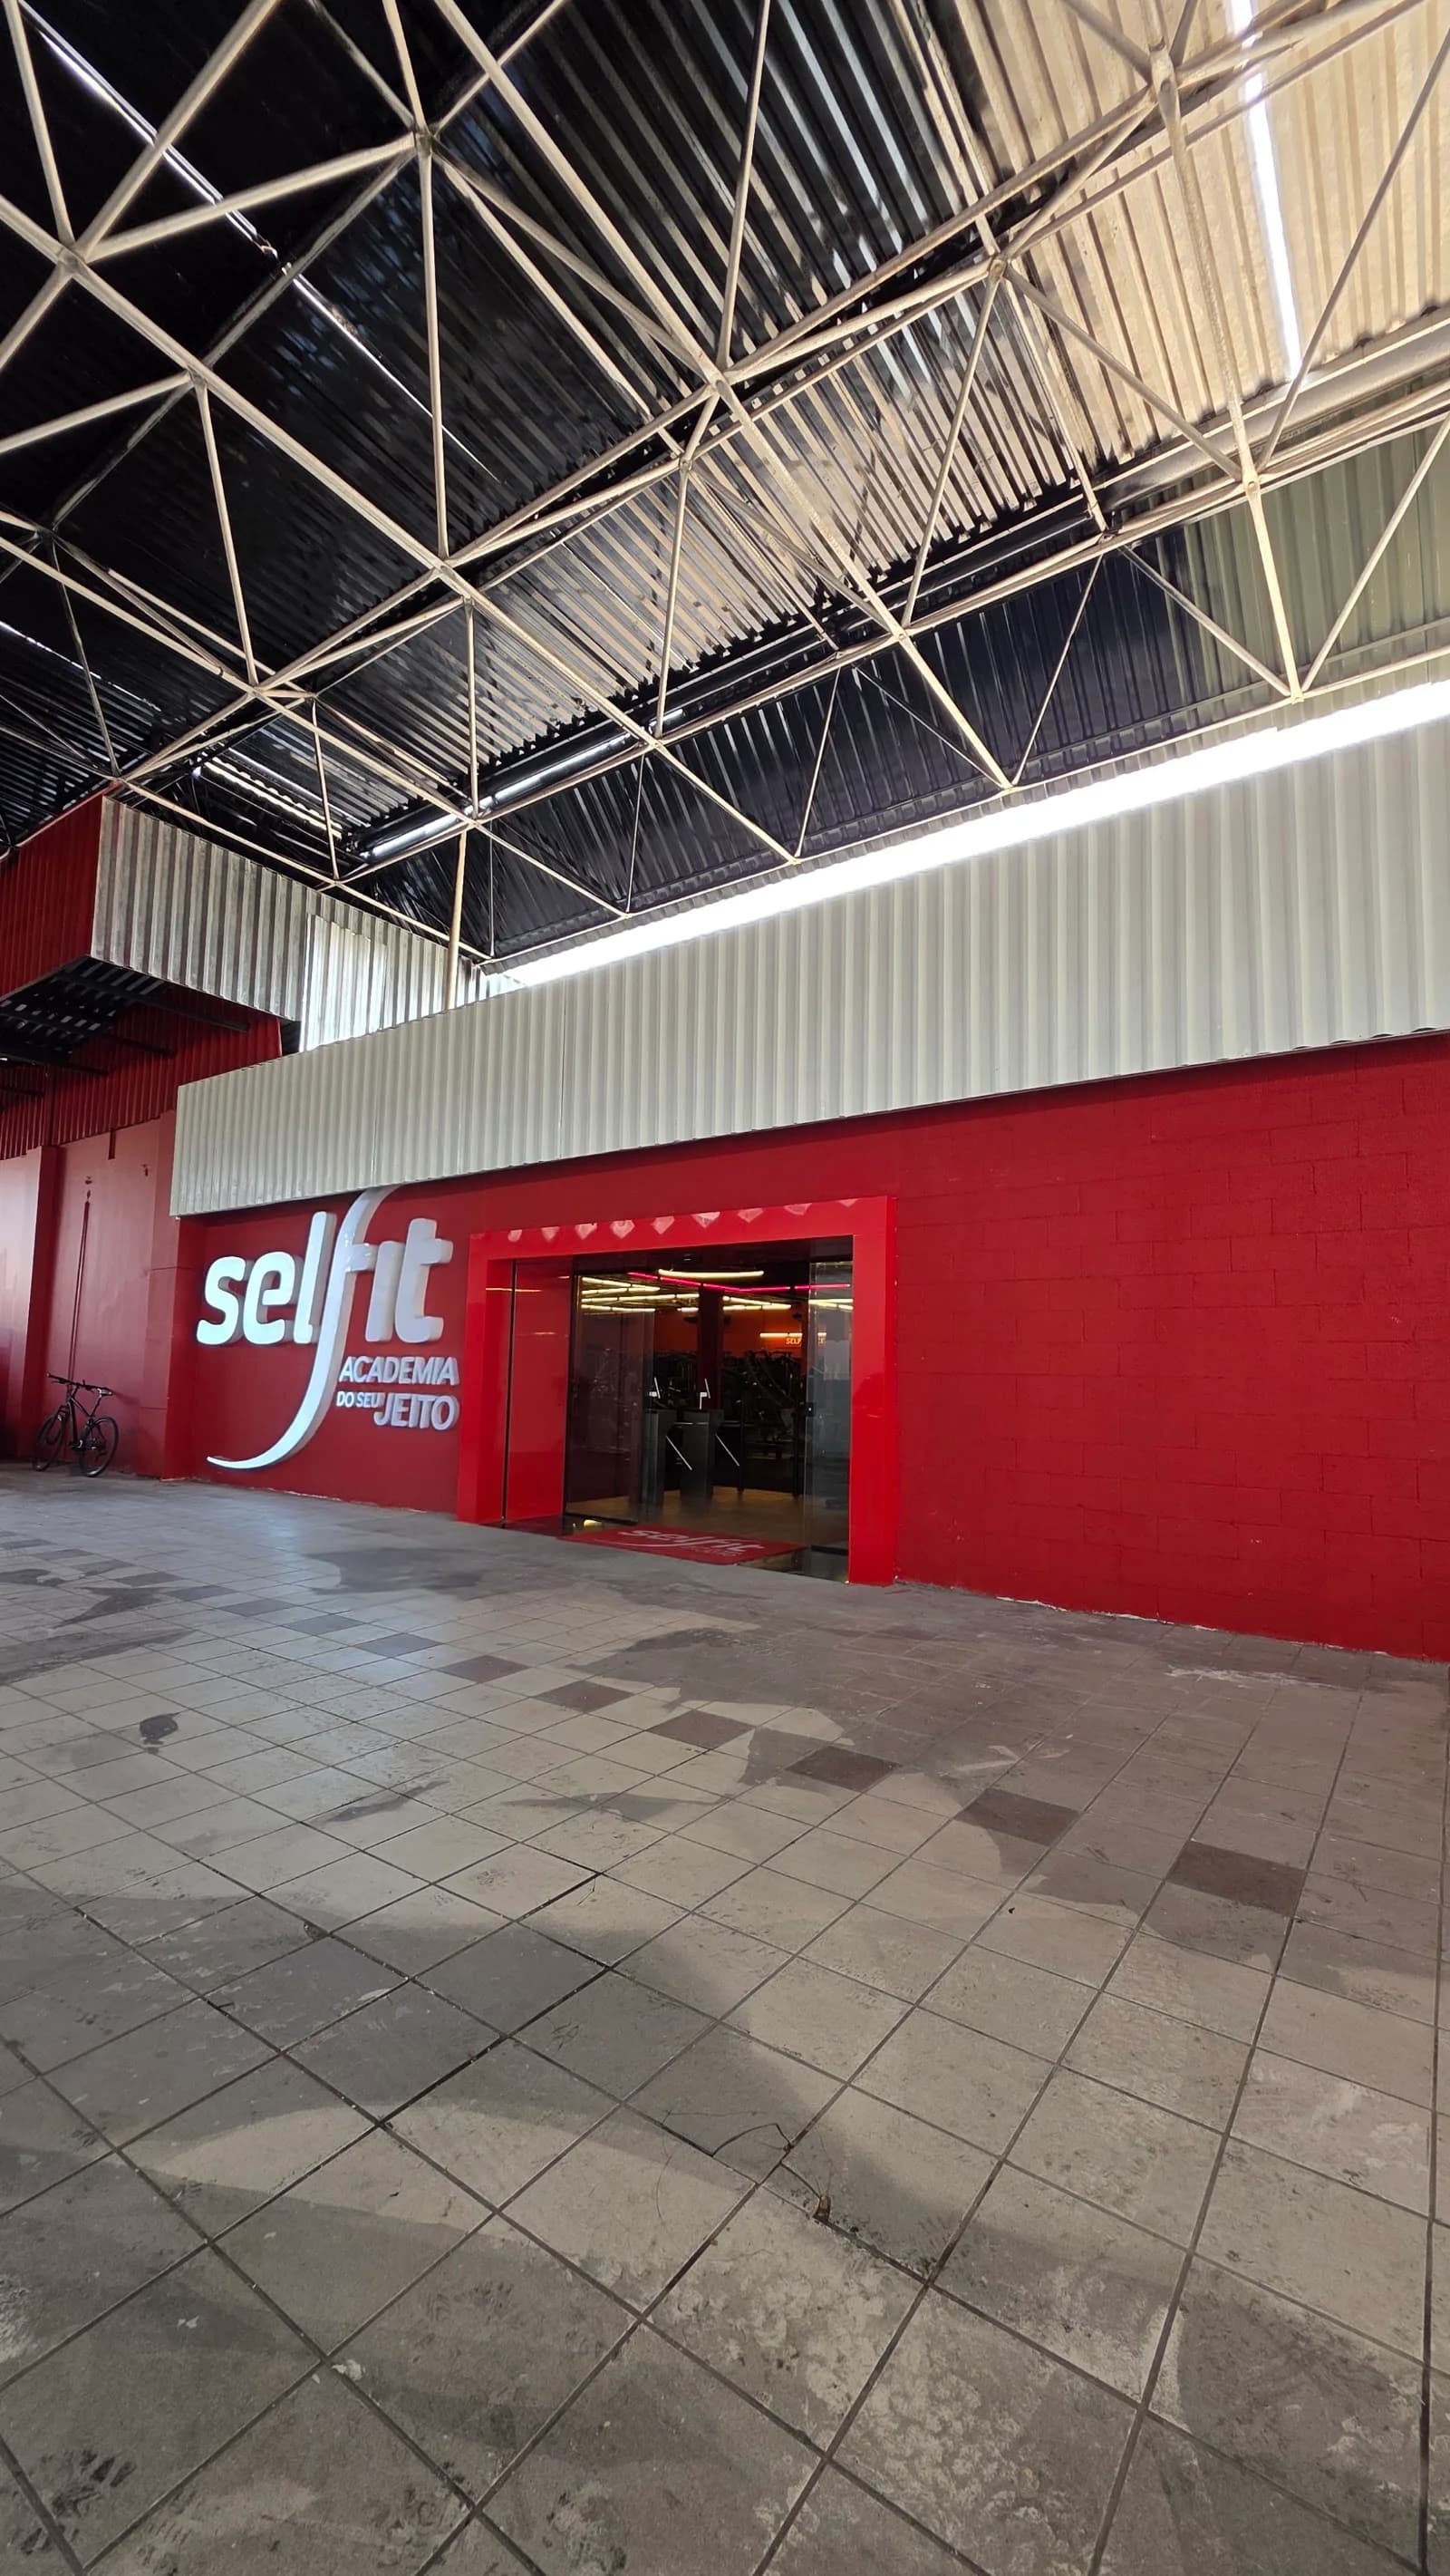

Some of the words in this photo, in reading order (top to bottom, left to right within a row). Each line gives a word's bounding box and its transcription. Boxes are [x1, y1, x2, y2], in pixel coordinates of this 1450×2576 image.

[197, 1186, 454, 1470] selfit
[339, 1355, 460, 1386] ACADEMIA
[336, 1390, 354, 1408] DO
[355, 1390, 385, 1409] SEU
[373, 1392, 460, 1431] JEITO
